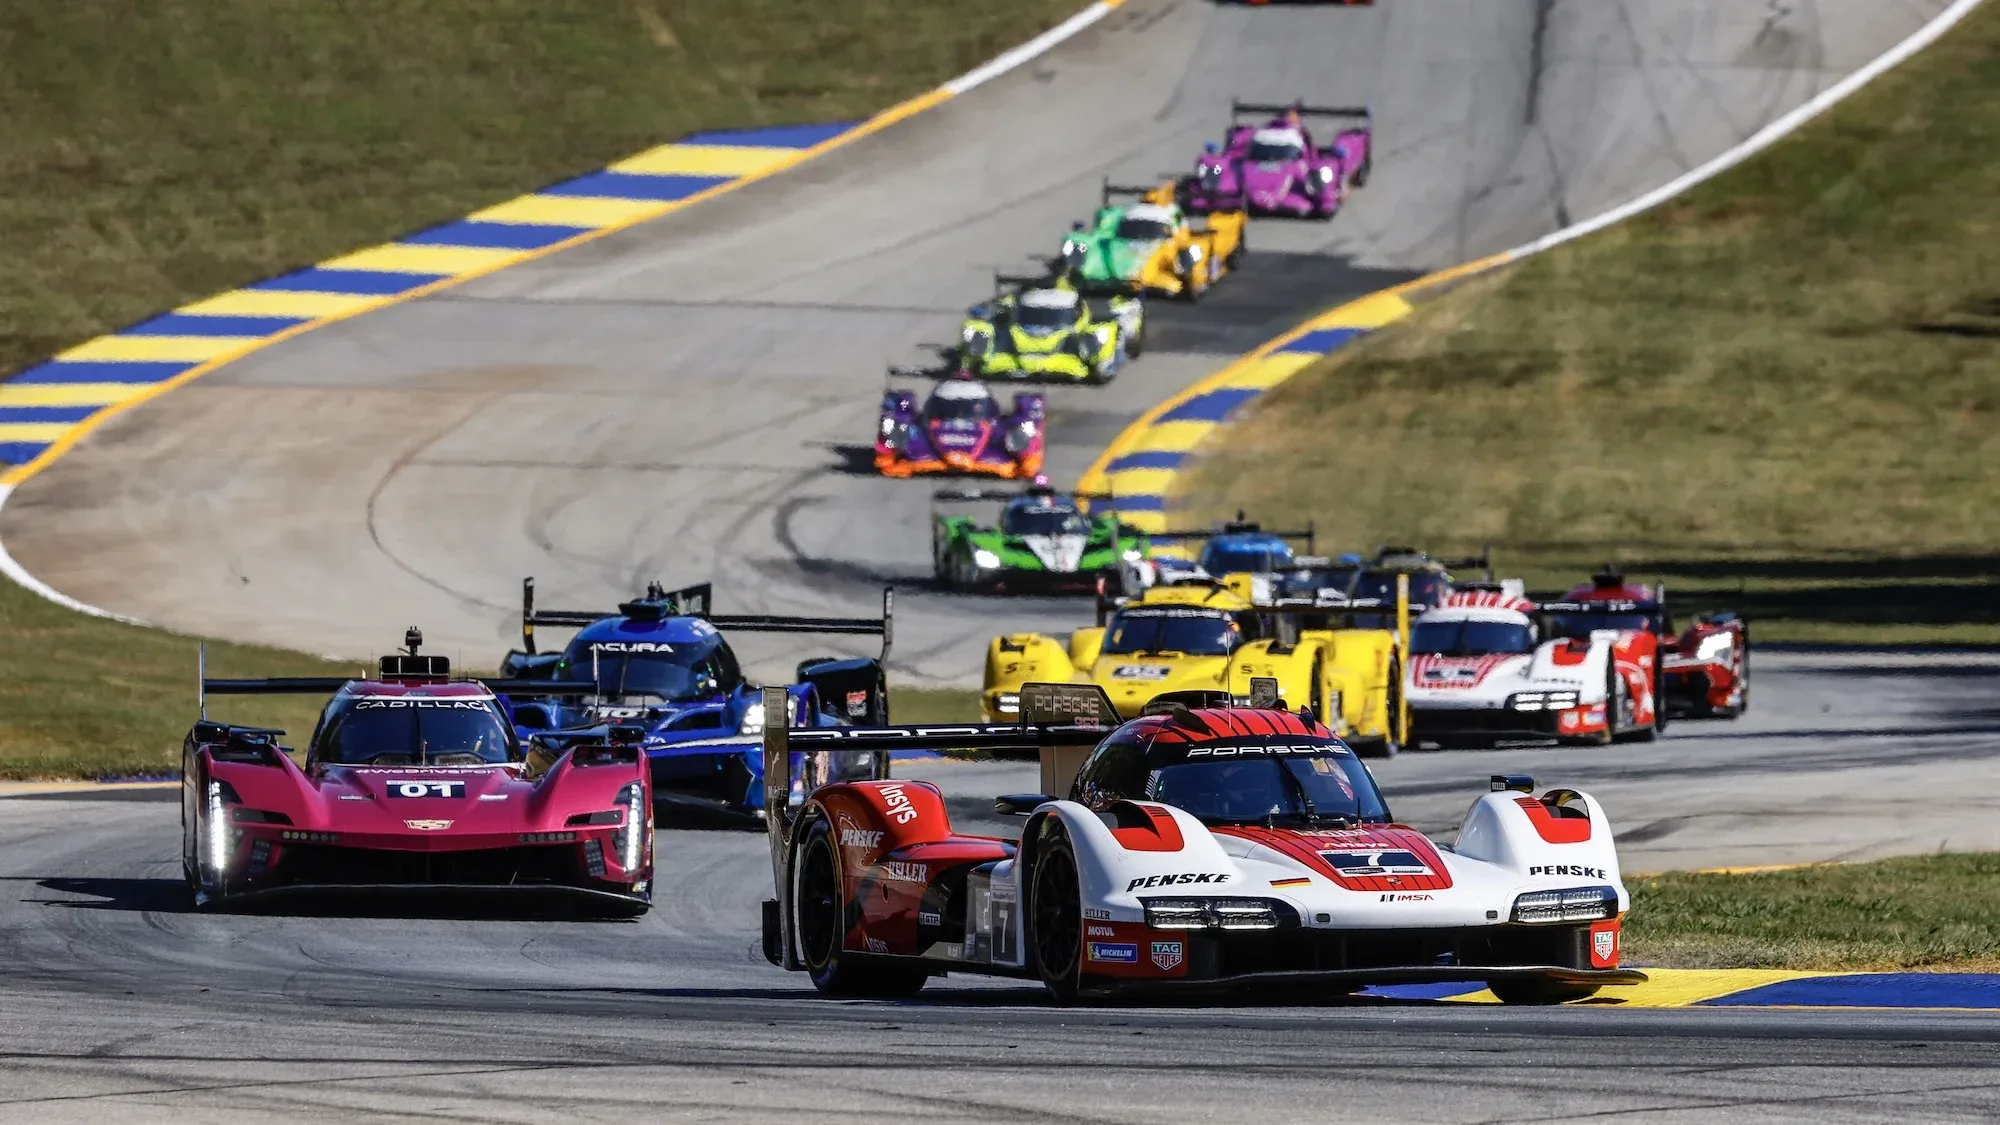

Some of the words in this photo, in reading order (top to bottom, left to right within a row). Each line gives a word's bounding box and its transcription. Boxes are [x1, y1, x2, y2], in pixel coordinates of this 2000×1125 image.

[589, 642, 675, 653] ACURA
[356, 701, 487, 711] CADILLAC
[1035, 694, 1099, 714] PORSCHE
[1187, 744, 1349, 758] PORSCHE
[399, 784, 452, 798] 01
[840, 828, 884, 849] PENSKE
[1350, 852, 1384, 867] 7
[888, 861, 928, 884] HELLER
[1529, 864, 1608, 880] PENSKE
[1125, 872, 1232, 893] PENSKE
[1084, 908, 1111, 920] HELLER
[1087, 925, 1115, 937] MOTUL
[1100, 948, 1133, 957] MICHELIN
[1155, 943, 1180, 953] TAG
[1153, 955, 1181, 972] HEUER
